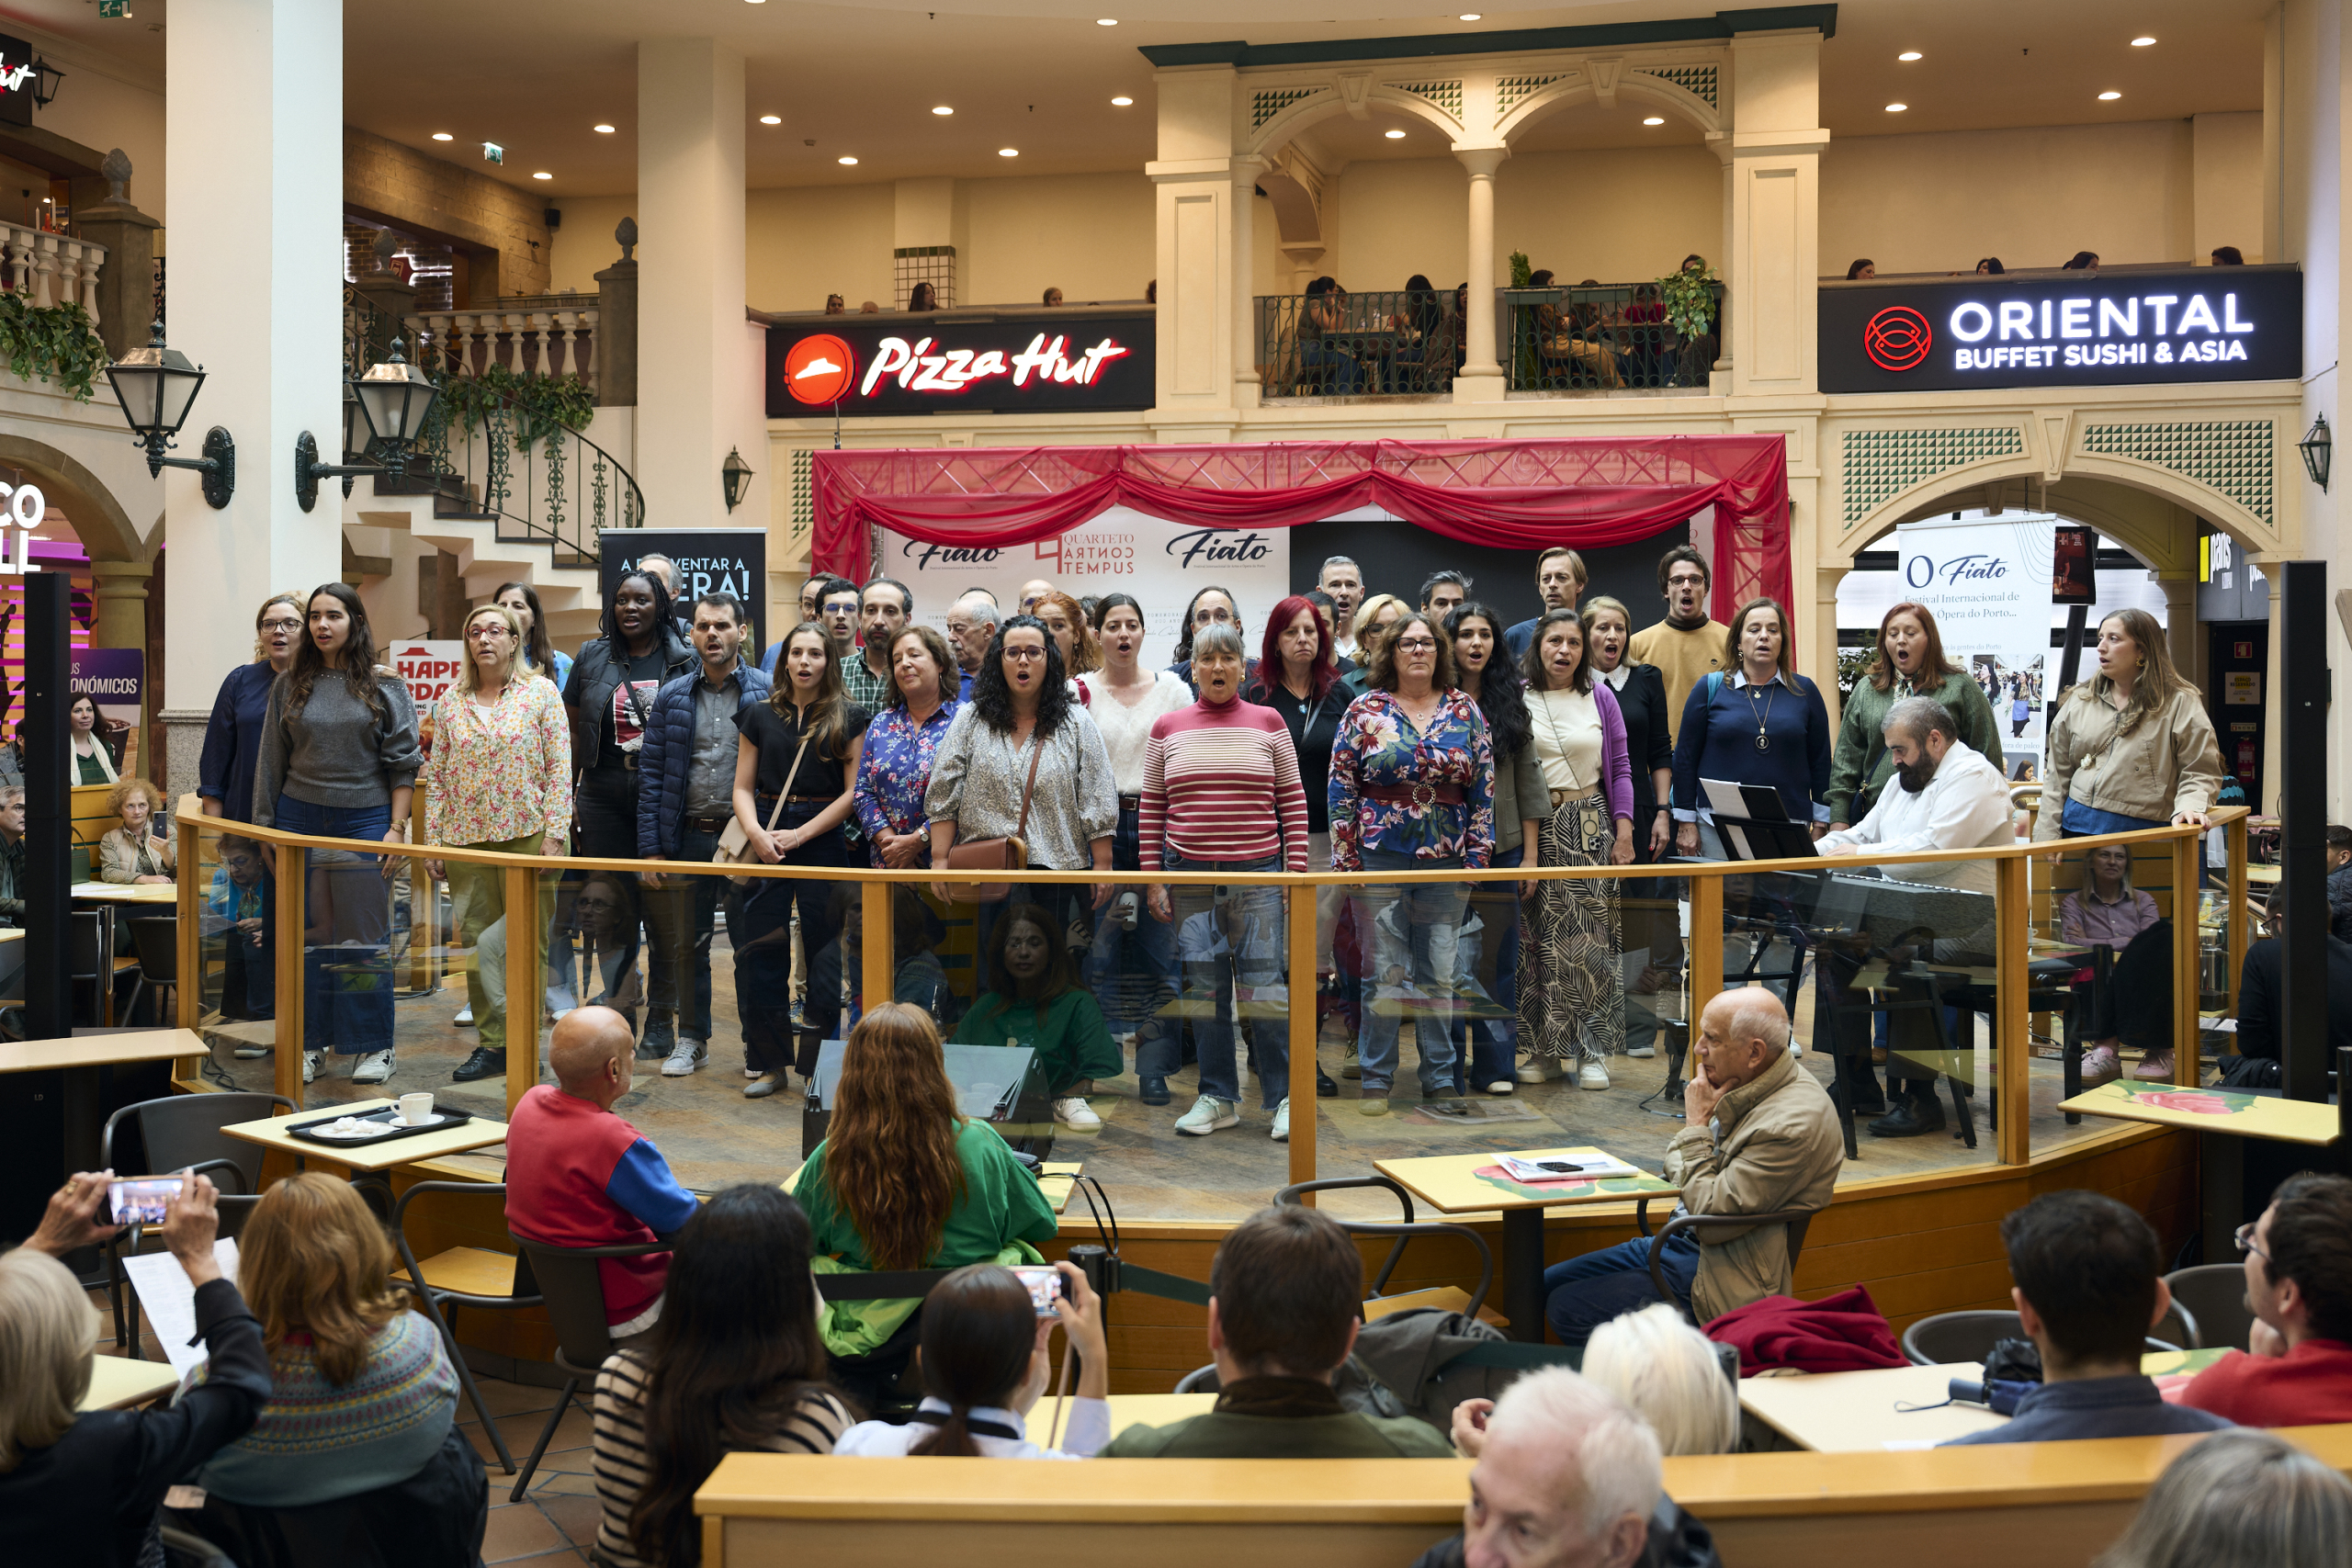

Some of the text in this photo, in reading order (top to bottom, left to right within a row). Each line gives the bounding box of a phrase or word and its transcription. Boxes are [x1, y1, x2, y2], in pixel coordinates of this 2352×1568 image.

[0, 52, 36, 92] ut
[1950, 293, 2254, 342] ORIENTAL
[861, 333, 1127, 396] Pizza Hut
[1955, 340, 2247, 369] BUFFET SUSHI & ASIA
[1064, 534, 1135, 546] QUARTETO
[1165, 527, 1273, 570] Fiato
[620, 558, 632, 571] A
[735, 558, 746, 570] A
[1063, 561, 1135, 574] TEMPUS
[2210, 531, 2232, 583] pans
[1906, 554, 2010, 589] O Fiato
[677, 570, 750, 602] ERA!
[1905, 591, 2020, 604] Festival Internacional de
[1937, 607, 1966, 621] Ópera
[1967, 608, 1981, 618] do
[397, 660, 461, 679] HAPP
[71, 675, 138, 694] ONÓMICOS
[2023, 741, 2041, 750] palco
